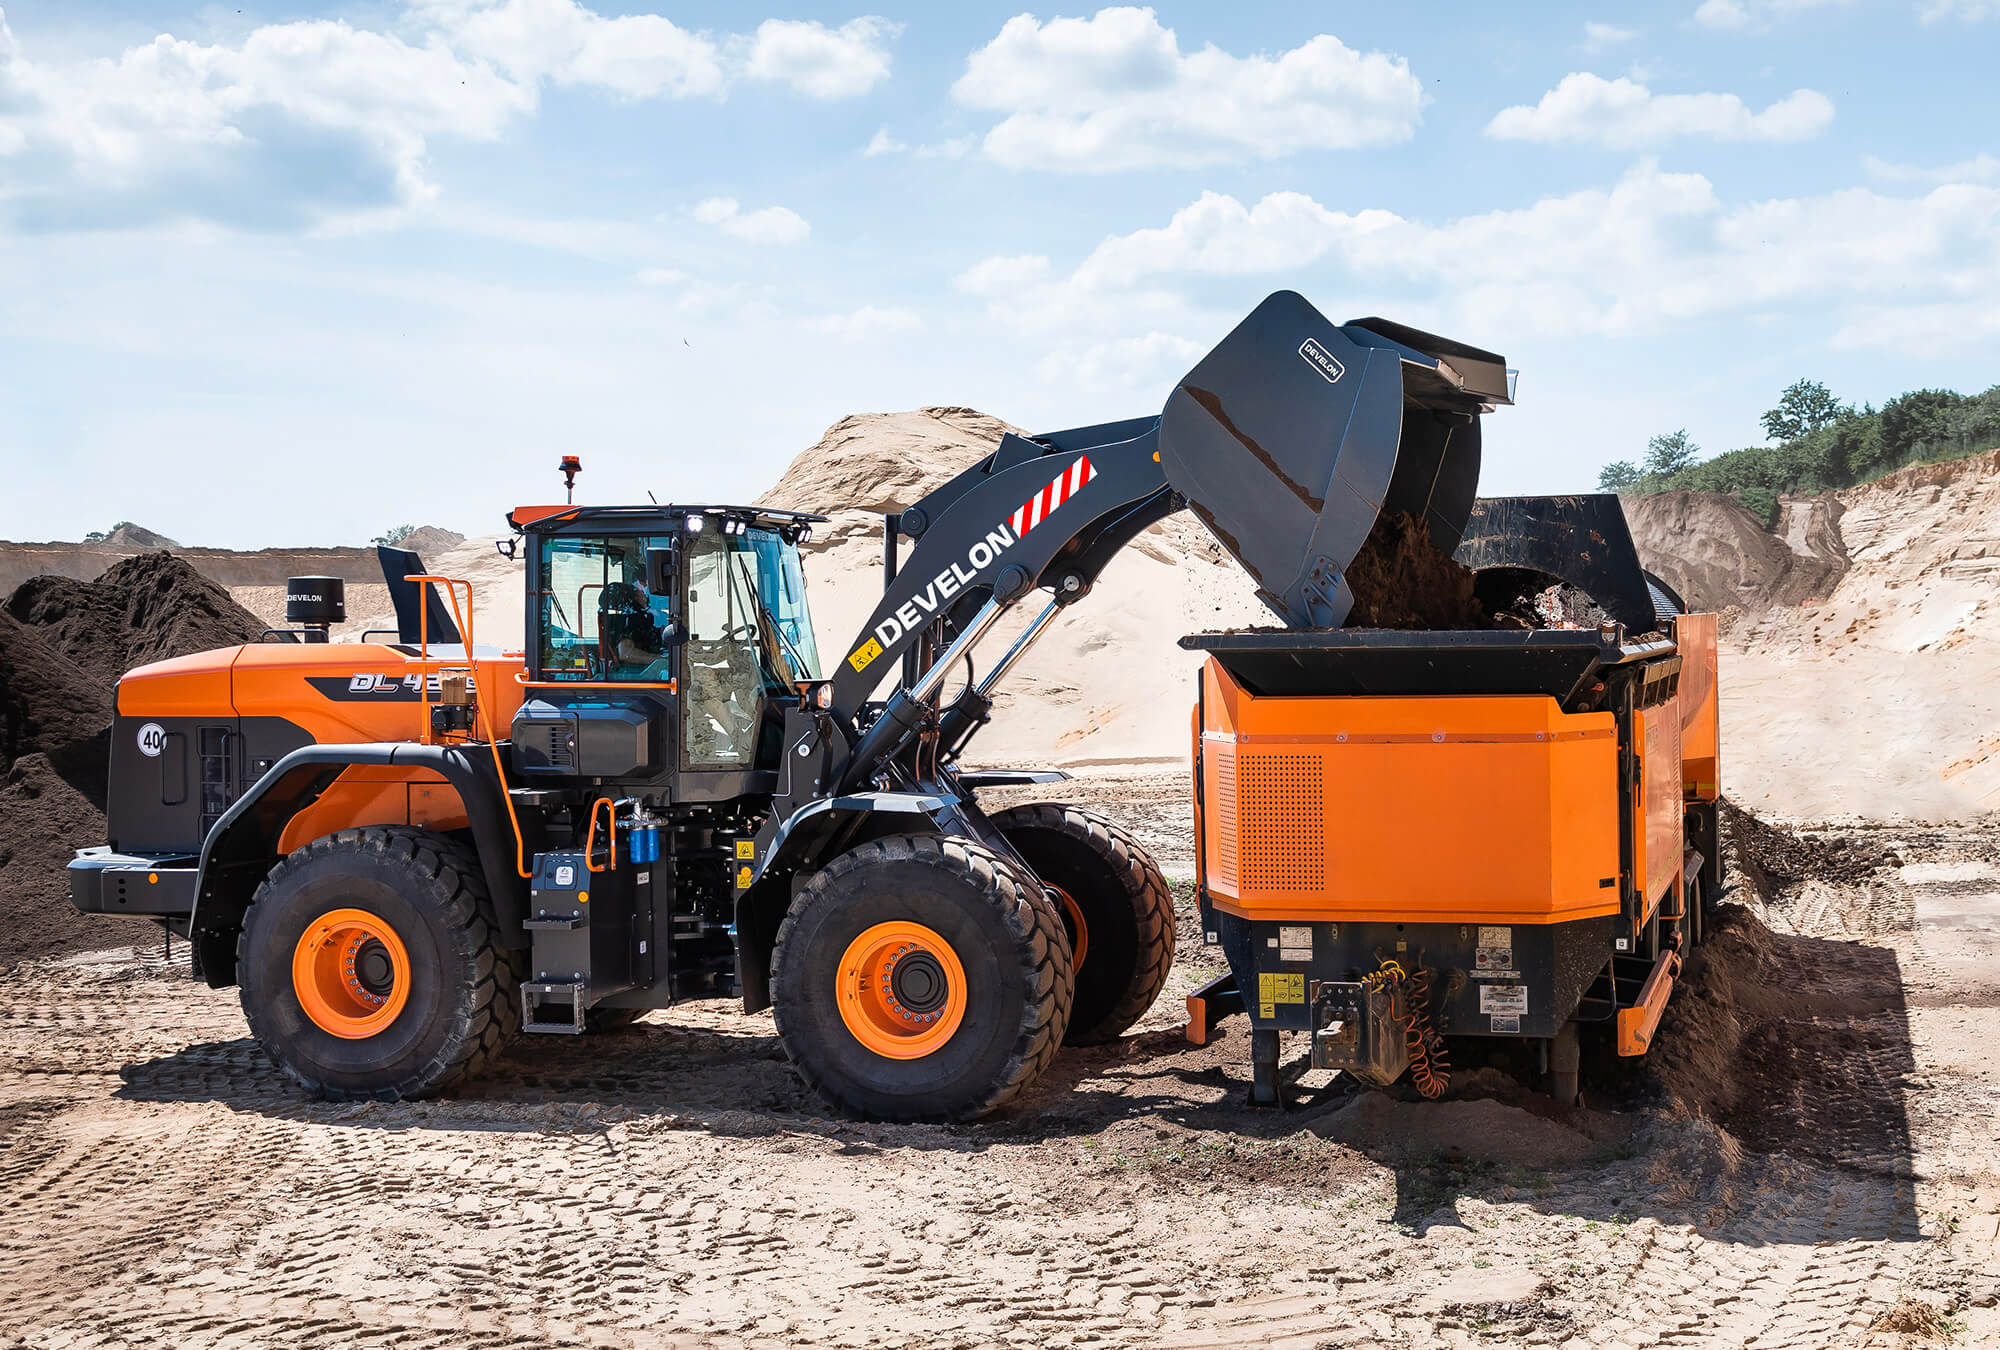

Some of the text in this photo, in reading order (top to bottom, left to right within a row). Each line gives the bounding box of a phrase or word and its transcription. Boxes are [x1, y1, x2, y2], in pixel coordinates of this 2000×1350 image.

[1304, 343, 1339, 377] DEVELON
[874, 523, 1015, 648] DEVELON
[287, 594, 322, 602] DEVELON
[349, 673, 399, 693] DL
[143, 730, 161, 749] 40
